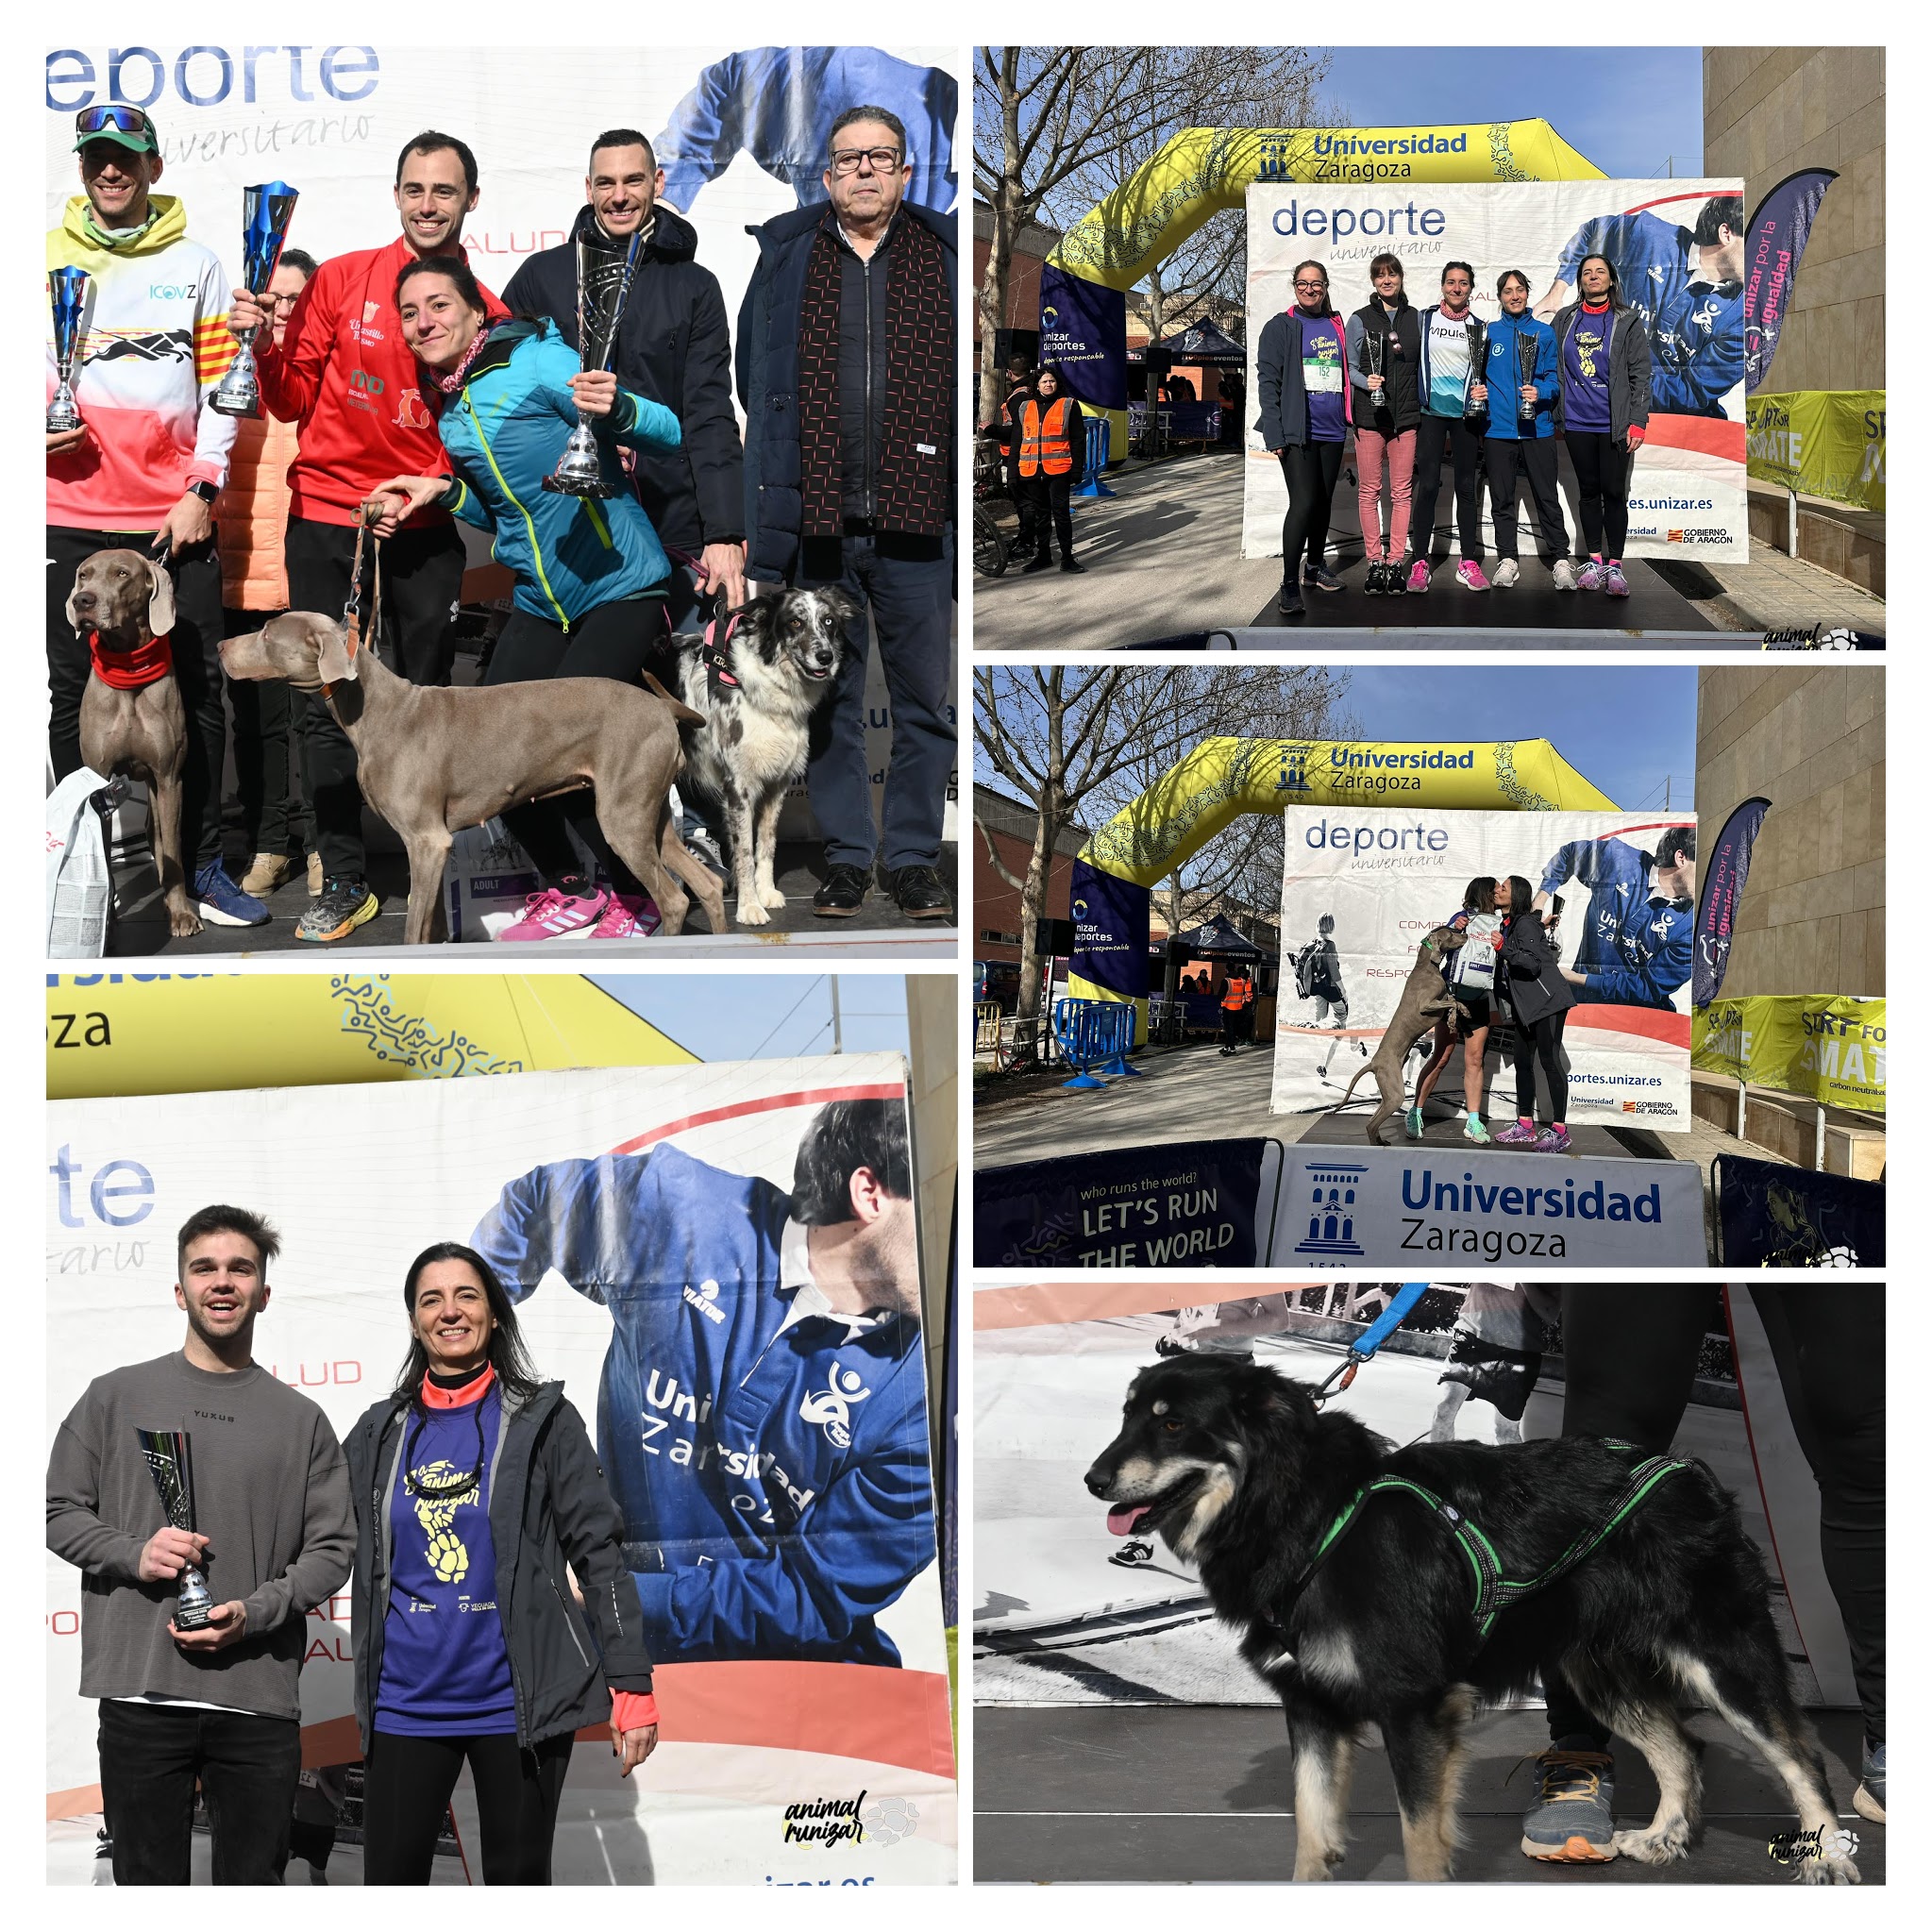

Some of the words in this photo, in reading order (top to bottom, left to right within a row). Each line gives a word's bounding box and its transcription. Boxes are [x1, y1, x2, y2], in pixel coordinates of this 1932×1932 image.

[1315, 133, 1467, 155] Universidad
[1315, 160, 1411, 182] Zaragoza
[1272, 199, 1446, 245] deporte
[1760, 221, 1776, 234] la
[1330, 238, 1444, 260] universitario
[1756, 237, 1771, 265] por
[1745, 266, 1762, 318] unizar
[1761, 250, 1792, 324] igualdad
[1043, 332, 1068, 341] unizar
[1043, 341, 1085, 351] deportes
[1043, 355, 1063, 365] deporte
[1064, 352, 1104, 362] responsable
[1319, 366, 1330, 377] 152
[1684, 529, 1727, 537] GOBIERNO
[1331, 748, 1474, 769] Universidad
[1331, 770, 1420, 794] Zaragoza
[1305, 818, 1449, 857] deporte
[1352, 852, 1446, 870] universitario
[474, 879, 499, 891] ADULT
[1706, 885, 1721, 931] unizar
[1717, 858, 1727, 883] por
[1722, 844, 1732, 856] la
[1092, 944, 1131, 952] responsable
[1829, 1081, 1852, 1092] carbon
[1571, 1097, 1614, 1105] Universidad
[49, 1143, 155, 1228] te
[1081, 1184, 1106, 1201] who
[1110, 1182, 1137, 1195] runs
[1141, 1178, 1160, 1191] the
[1162, 1171, 1198, 1186] world?
[1402, 1169, 1662, 1224] Universidad
[1168, 1187, 1218, 1221] RUN
[1079, 1242, 1136, 1268] THE
[1146, 1223, 1235, 1267] WORLD
[1401, 1218, 1567, 1263] Zaragoza
